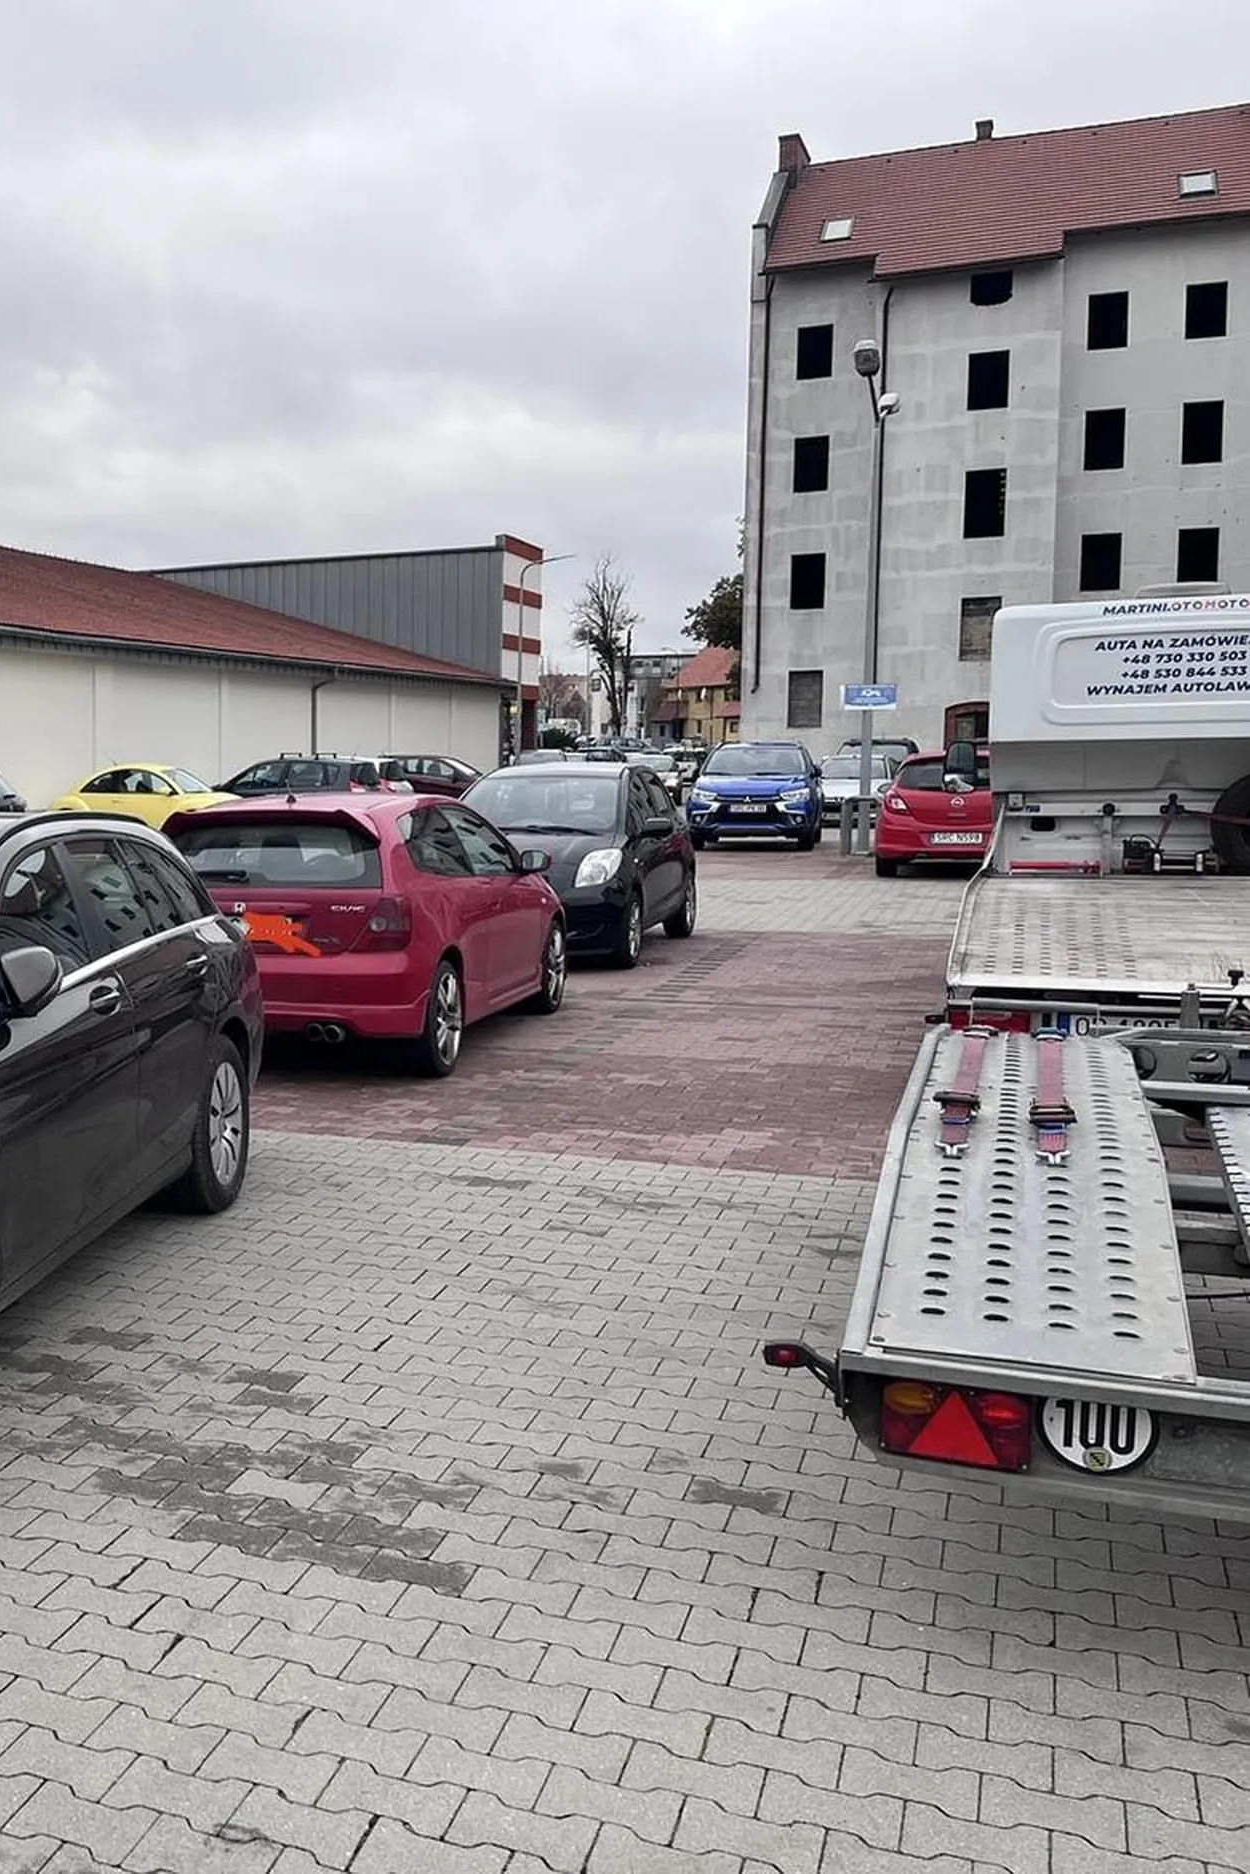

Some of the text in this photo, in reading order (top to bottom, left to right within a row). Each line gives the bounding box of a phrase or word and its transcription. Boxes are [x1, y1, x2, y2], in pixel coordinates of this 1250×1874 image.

[1095, 634, 1250, 651] AUTA NA ZAMÓWIE
[1123, 651, 1247, 664] +48 730 330 503
[1121, 666, 1247, 679] +48 530 844 533
[1087, 683, 1167, 695] WYNAJEM
[1056, 1399, 1137, 1455] 100
